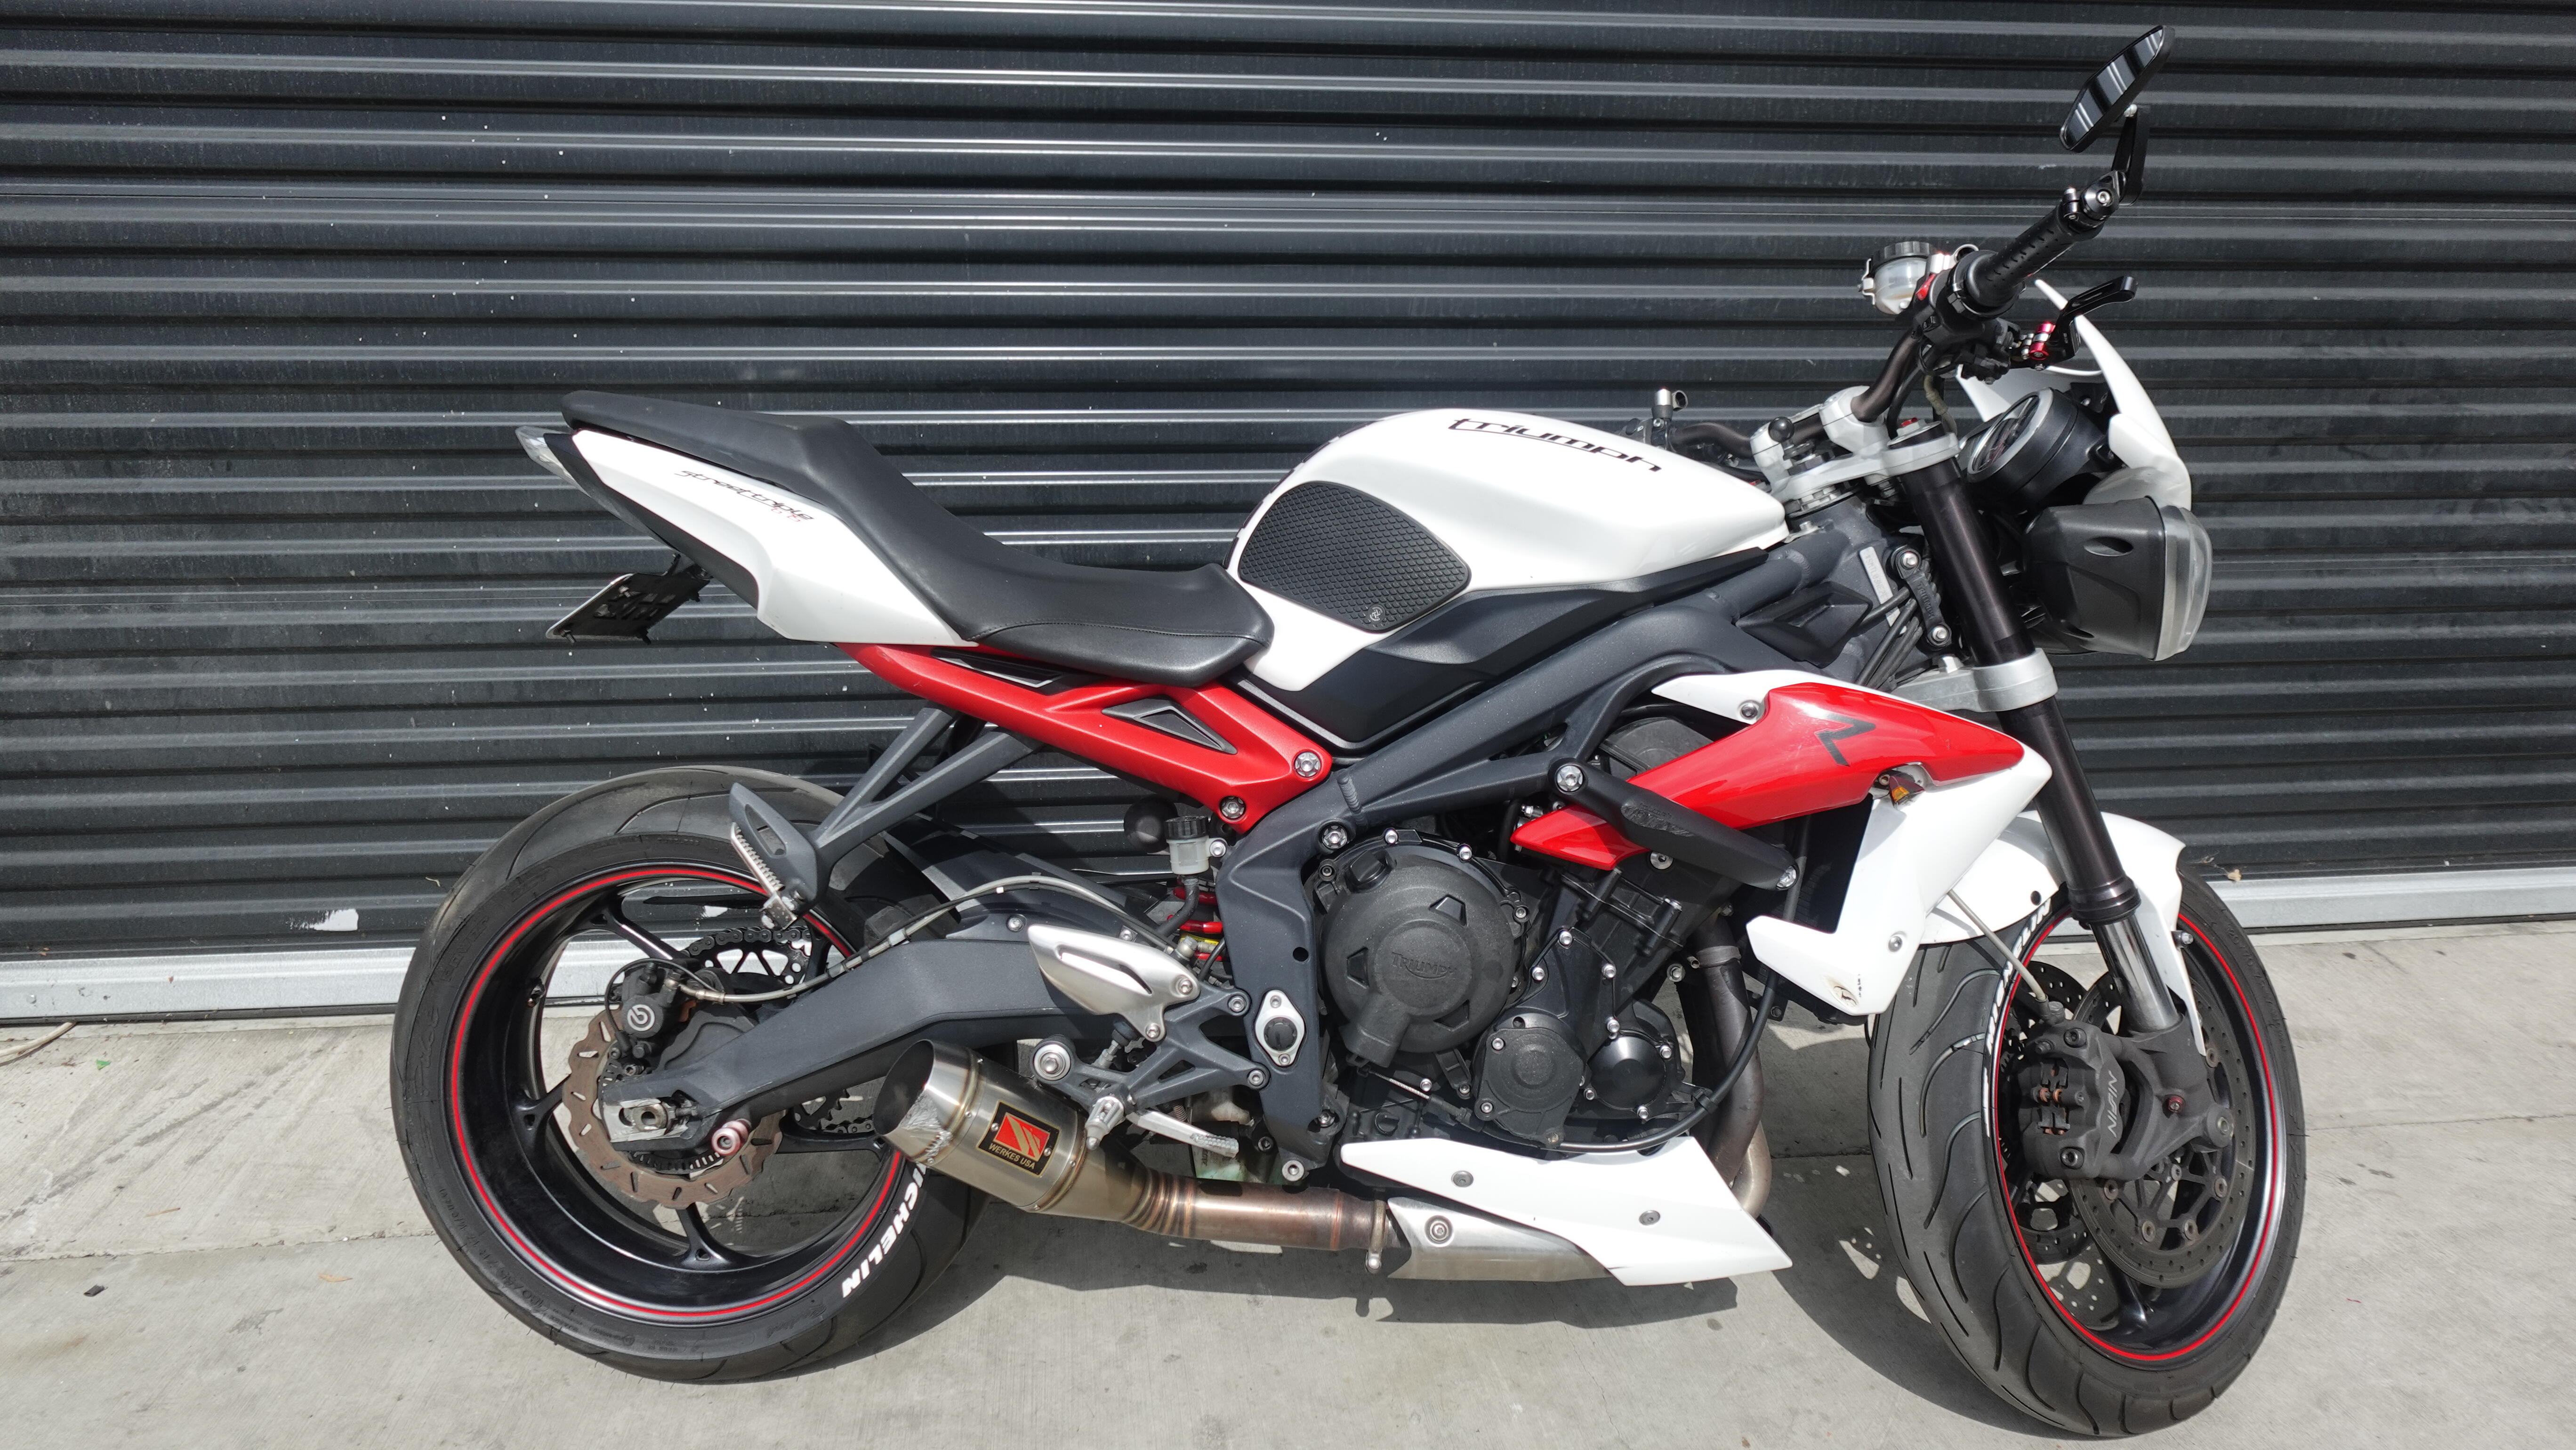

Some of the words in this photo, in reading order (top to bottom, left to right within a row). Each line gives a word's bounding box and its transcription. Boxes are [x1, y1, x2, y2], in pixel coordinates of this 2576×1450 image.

[988, 1143, 1021, 1162] WERKES
[1020, 1156, 1036, 1170] USA
[842, 1162, 927, 1298] ICHELIN
